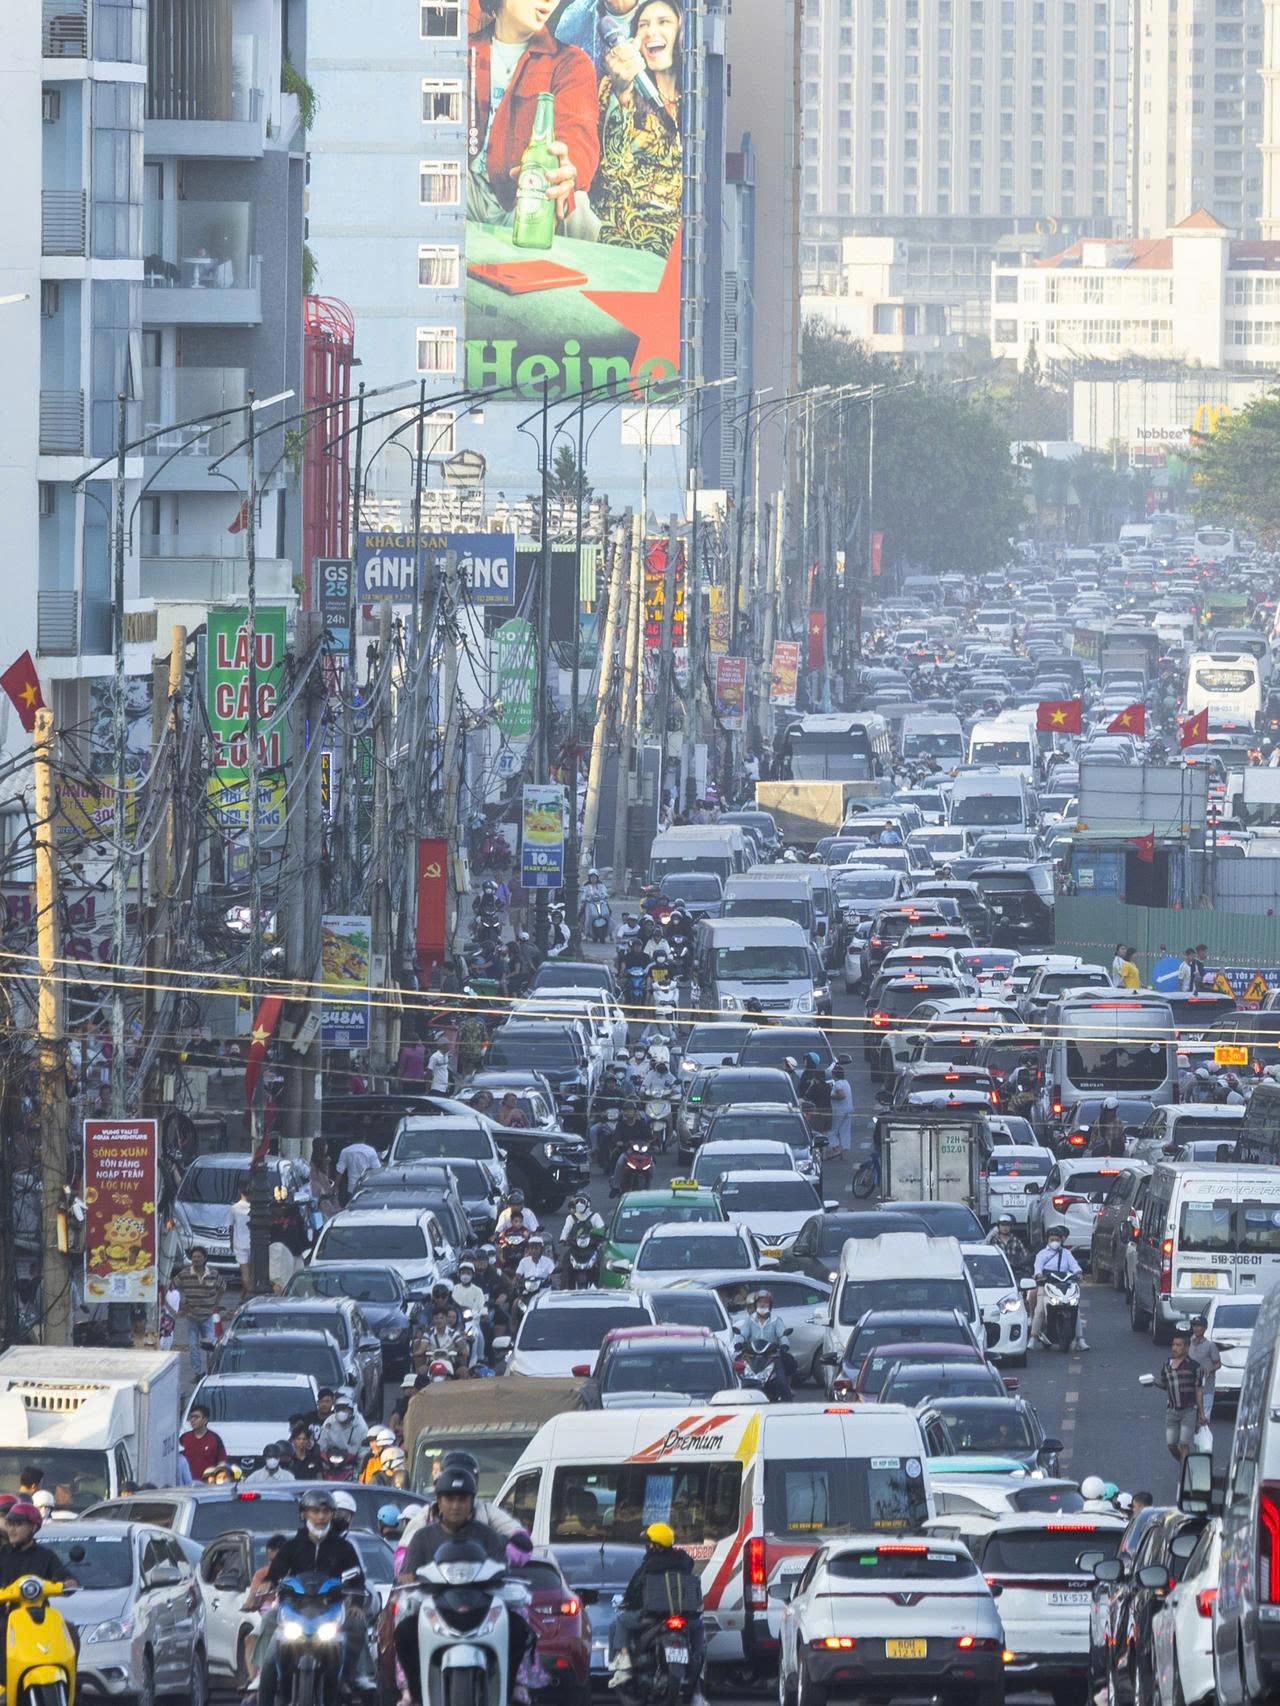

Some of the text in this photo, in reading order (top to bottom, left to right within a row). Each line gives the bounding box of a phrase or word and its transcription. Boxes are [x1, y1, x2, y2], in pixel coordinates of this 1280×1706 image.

[464, 339, 679, 401] Heine
[364, 535, 416, 548] KHÁCH
[324, 566, 348, 581] GS
[364, 549, 509, 591] ÁNH ĂNG
[325, 583, 347, 597] 25
[326, 614, 346, 625] 24h
[215, 676, 277, 720] CÁC
[945, 1135, 960, 1143] 72H
[657, 1425, 724, 1459] Premium
